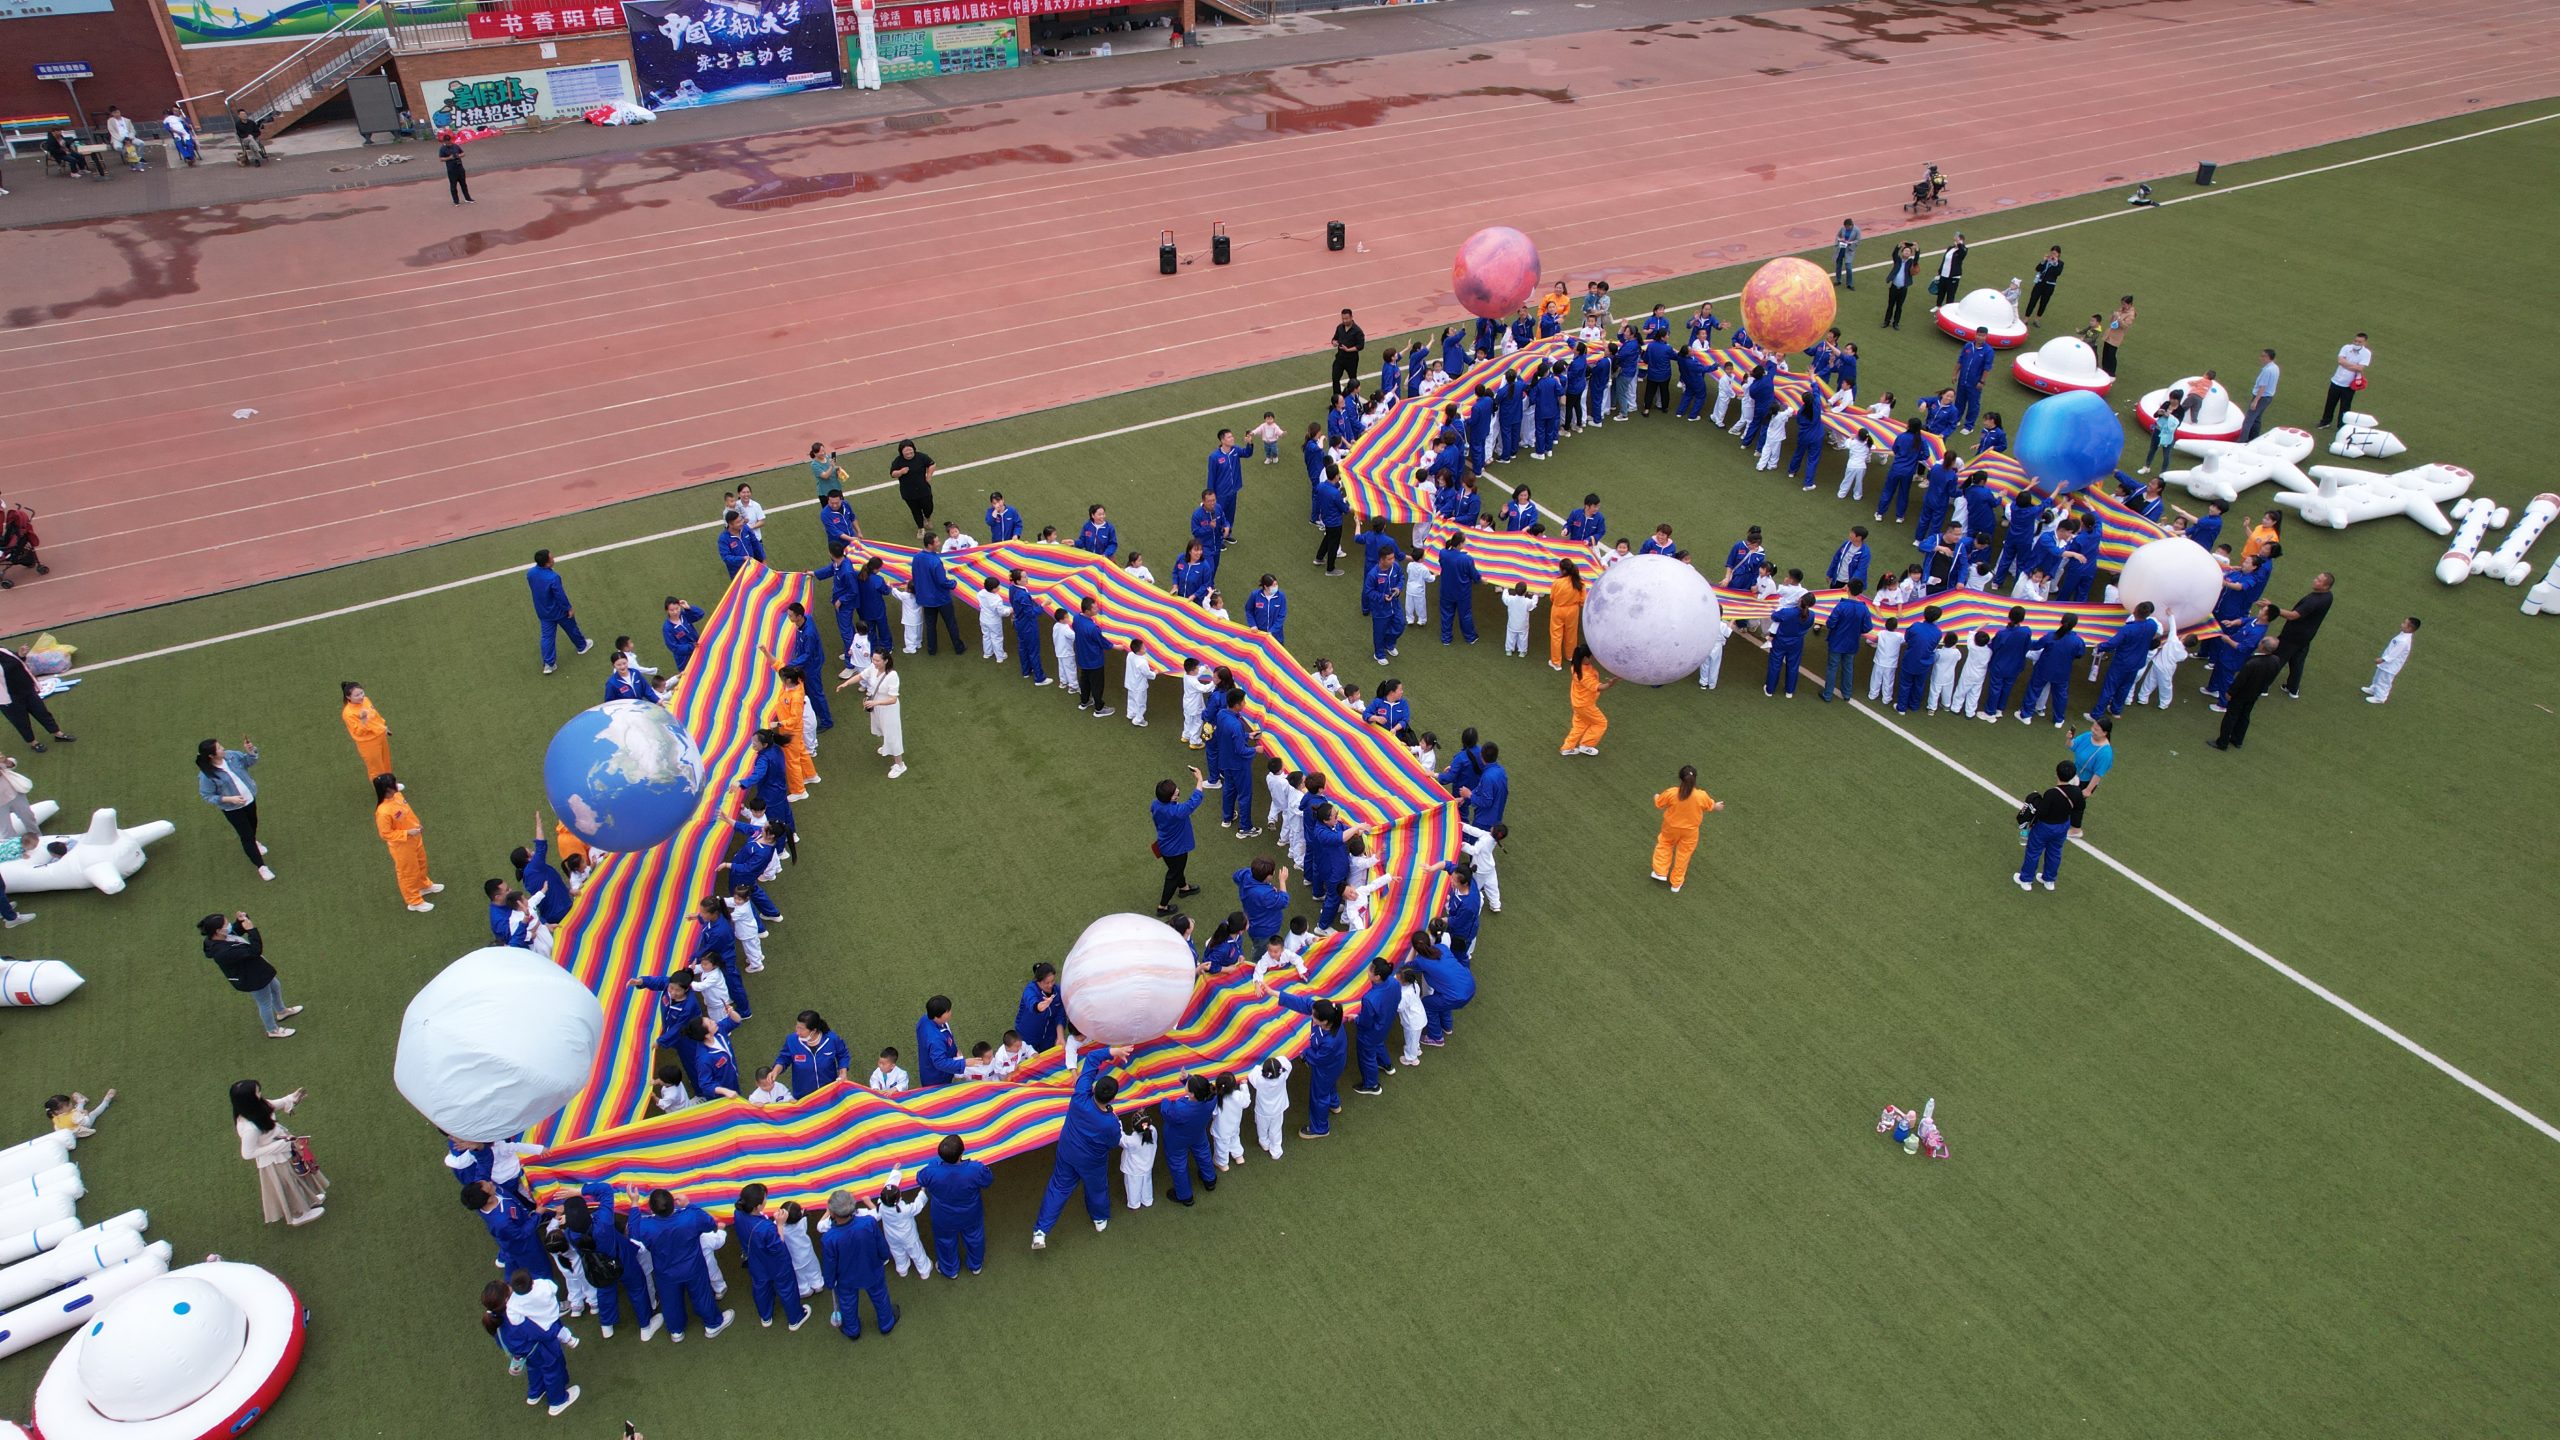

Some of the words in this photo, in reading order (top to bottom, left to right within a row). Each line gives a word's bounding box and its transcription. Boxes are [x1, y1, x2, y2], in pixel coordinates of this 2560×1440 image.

[697, 45, 793, 73] 亲子运动会
[453, 78, 525, 110] 暑假班
[451, 100, 535, 127] 火热招生中
